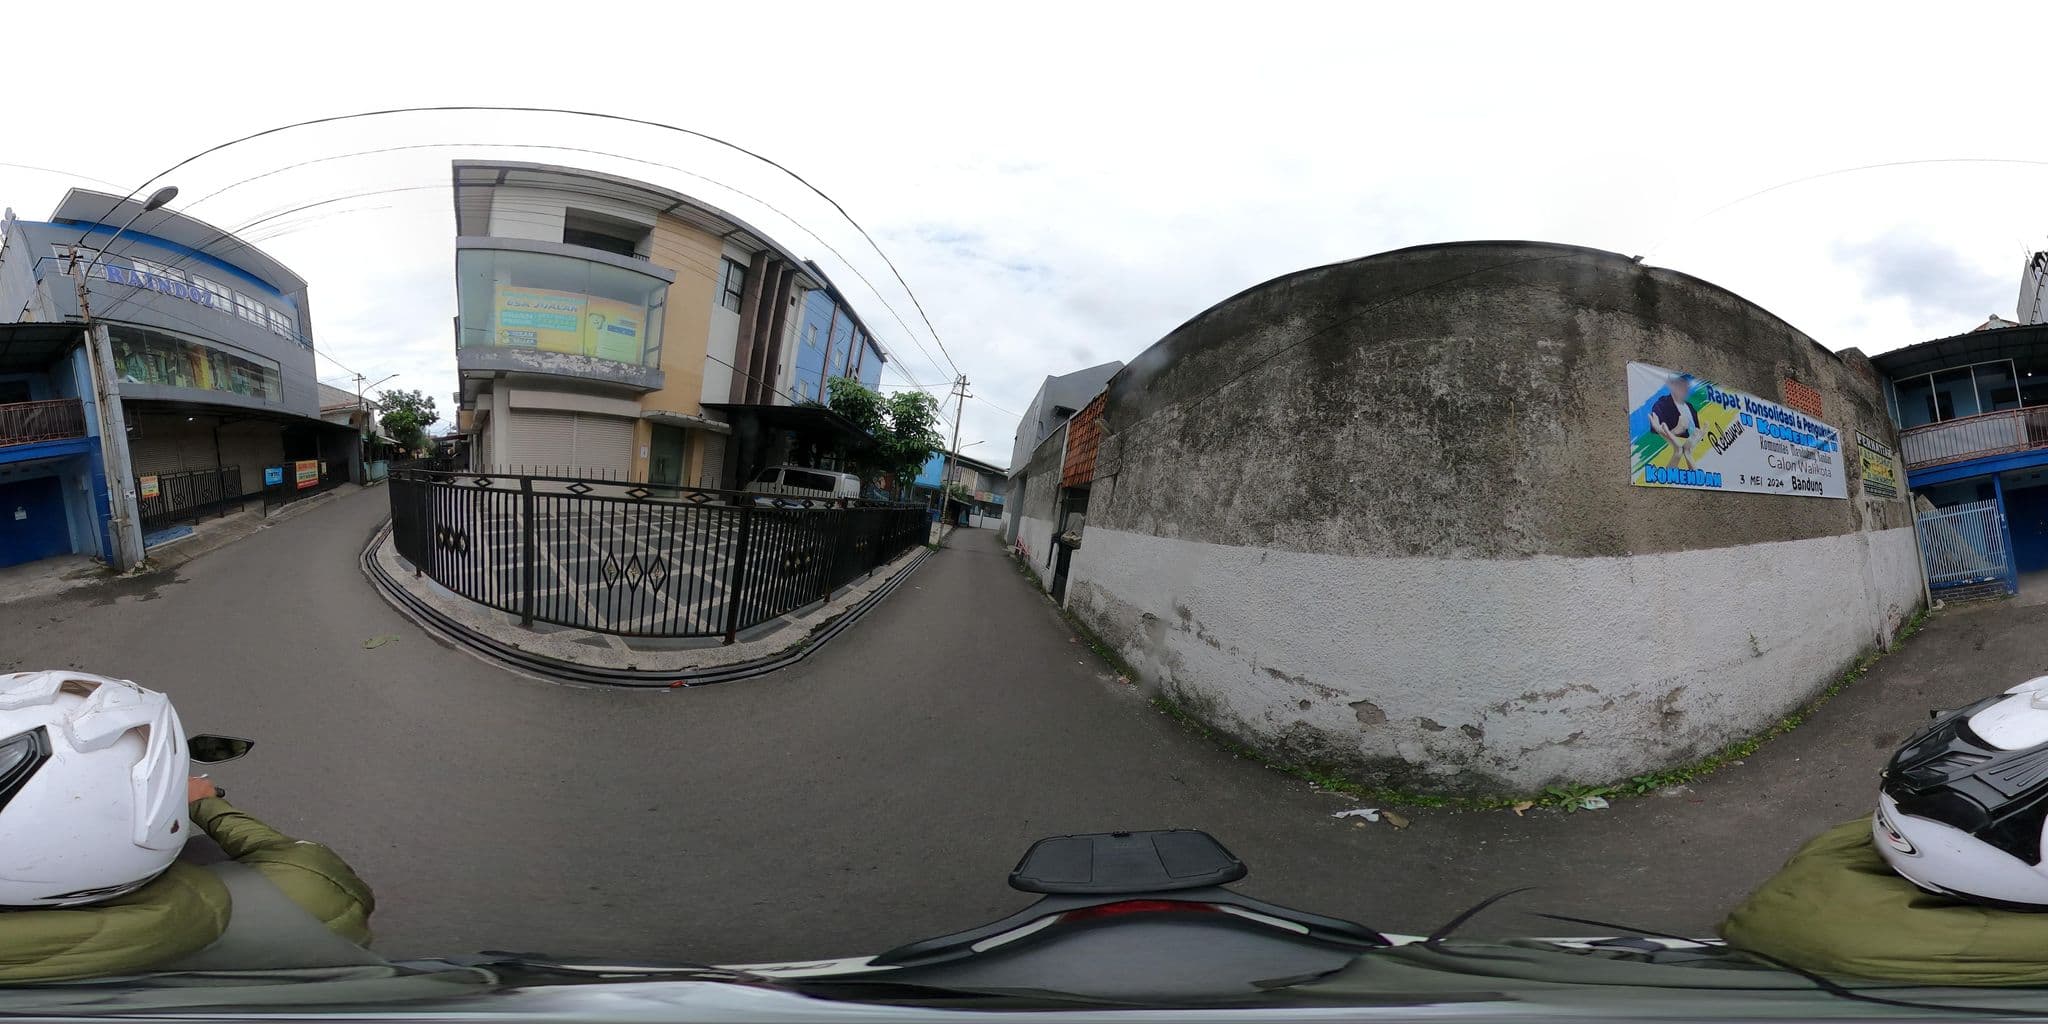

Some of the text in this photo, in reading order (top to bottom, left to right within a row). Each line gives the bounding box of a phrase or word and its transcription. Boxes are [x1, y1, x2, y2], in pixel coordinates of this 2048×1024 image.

[1706, 385, 1741, 409] Rapat
[1744, 397, 1795, 427] Konsolidasi
[1796, 414, 1803, 430] &
[1707, 421, 1745, 455] Relawan
[1767, 454, 1832, 478] Calon Walikota
[1739, 474, 1784, 488] 3 MEI 2024
[1791, 475, 1823, 495] Bandung
